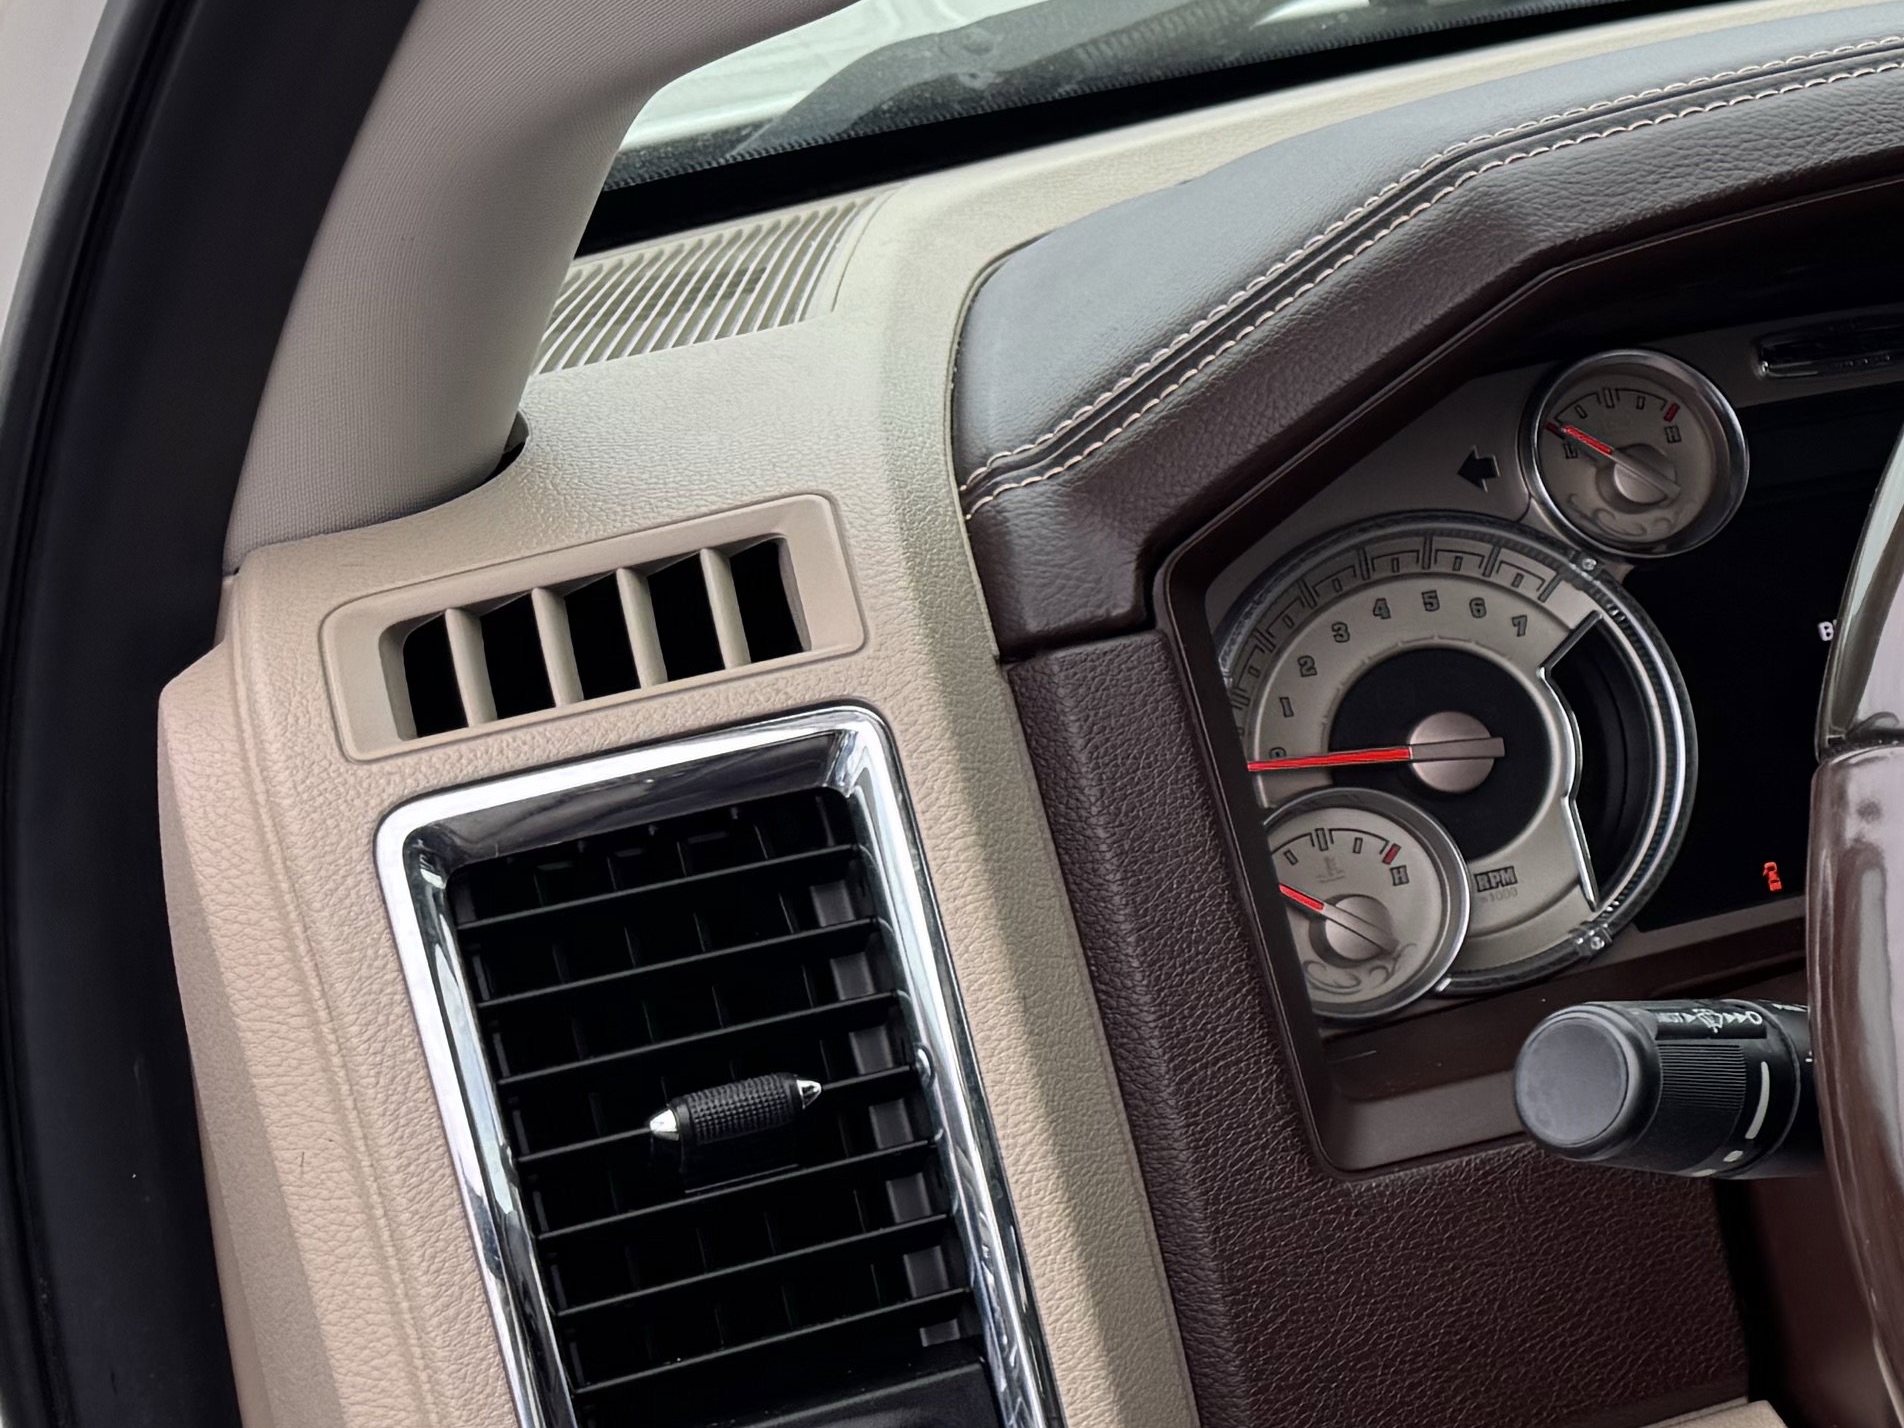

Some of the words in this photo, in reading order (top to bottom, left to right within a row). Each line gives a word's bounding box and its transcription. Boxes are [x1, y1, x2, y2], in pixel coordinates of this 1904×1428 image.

[1372, 598, 1391, 620] 4
[1420, 590, 1440, 613] 5
[1469, 597, 1487, 619] 6
[1331, 622, 1350, 643] 3
[1511, 615, 1528, 637] 7
[1297, 655, 1317, 677] 2
[1279, 697, 1294, 717] 1
[1389, 865, 1409, 886] H
[1474, 866, 1518, 892] RPM
